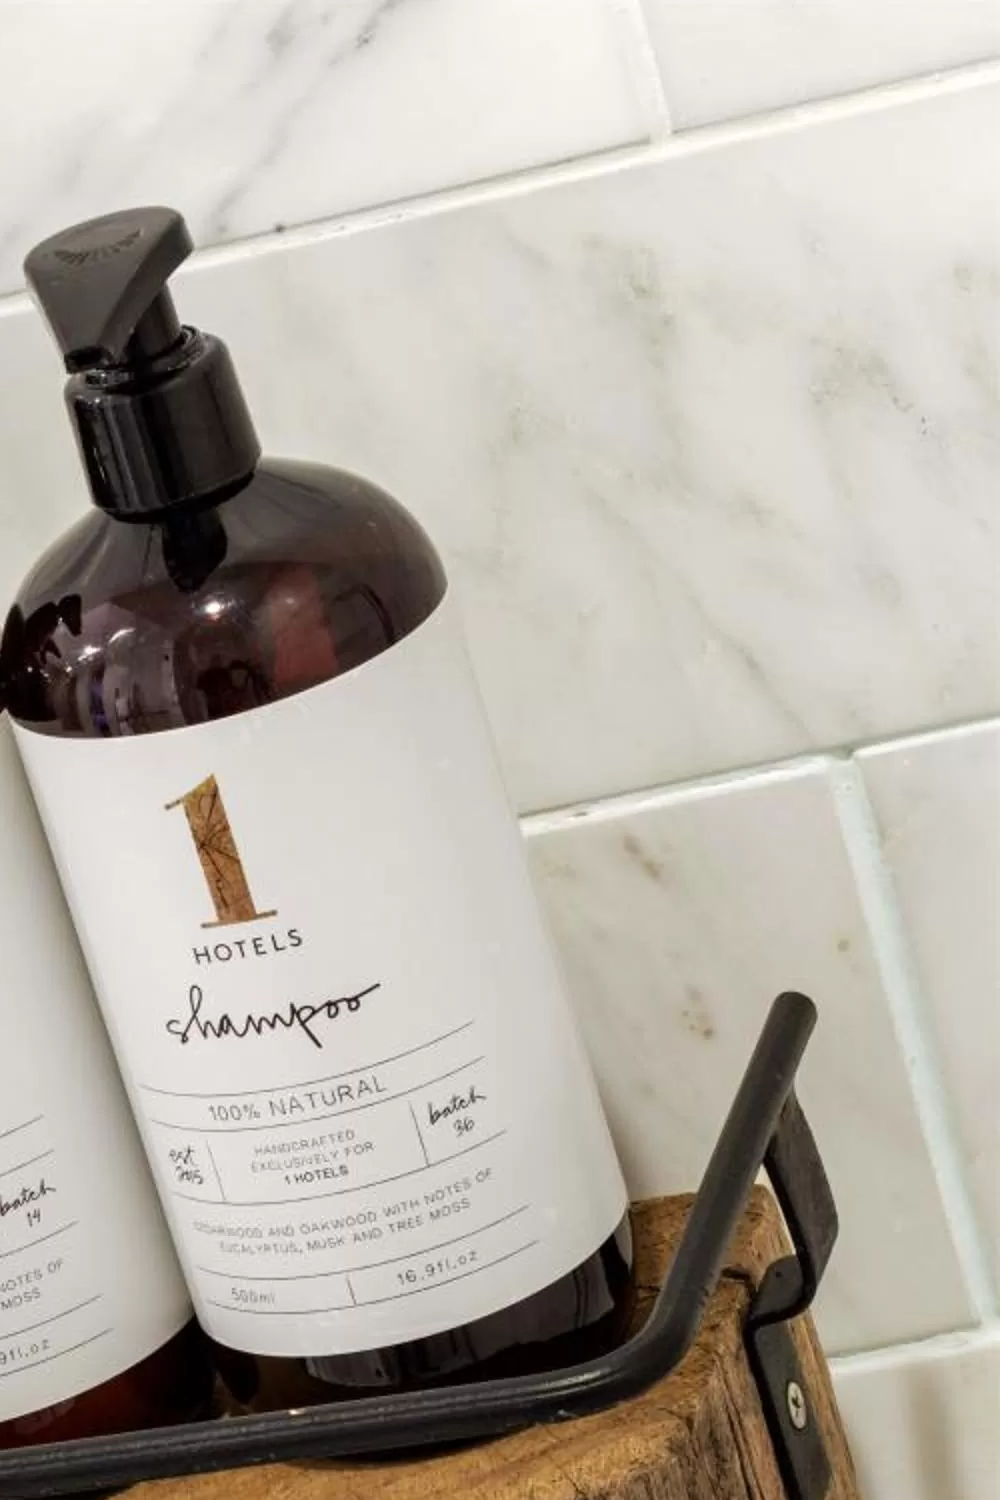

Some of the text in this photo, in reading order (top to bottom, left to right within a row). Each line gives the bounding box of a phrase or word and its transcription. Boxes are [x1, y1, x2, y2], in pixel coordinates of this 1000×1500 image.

[164, 773, 278, 929] 1
[192, 928, 303, 964] HOTELS
[166, 983, 381, 1049] shampoo
[208, 1074, 388, 1122] 100% NATURAL
[427, 1084, 487, 1125] batch
[250, 1140, 375, 1174] EXCLUSIVELY FOR
[254, 1129, 355, 1156] HANDCRAFTED
[294, 1164, 349, 1184] HOTELS
[268, 1225, 295, 1238] AND
[299, 1210, 377, 1235] OAKWOOD
[383, 1198, 420, 1220] WITH
[423, 1178, 472, 1205] NOTES
[475, 1167, 494, 1185] OF
[306, 1236, 345, 1251] MUSK
[353, 1227, 382, 1246] AND
[388, 1214, 424, 1237] TREE
[428, 1198, 471, 1223] MOSS
[47, 1258, 65, 1276] OF
[0, 1287, 42, 1313] MOSS
[231, 1286, 276, 1304] 500ml
